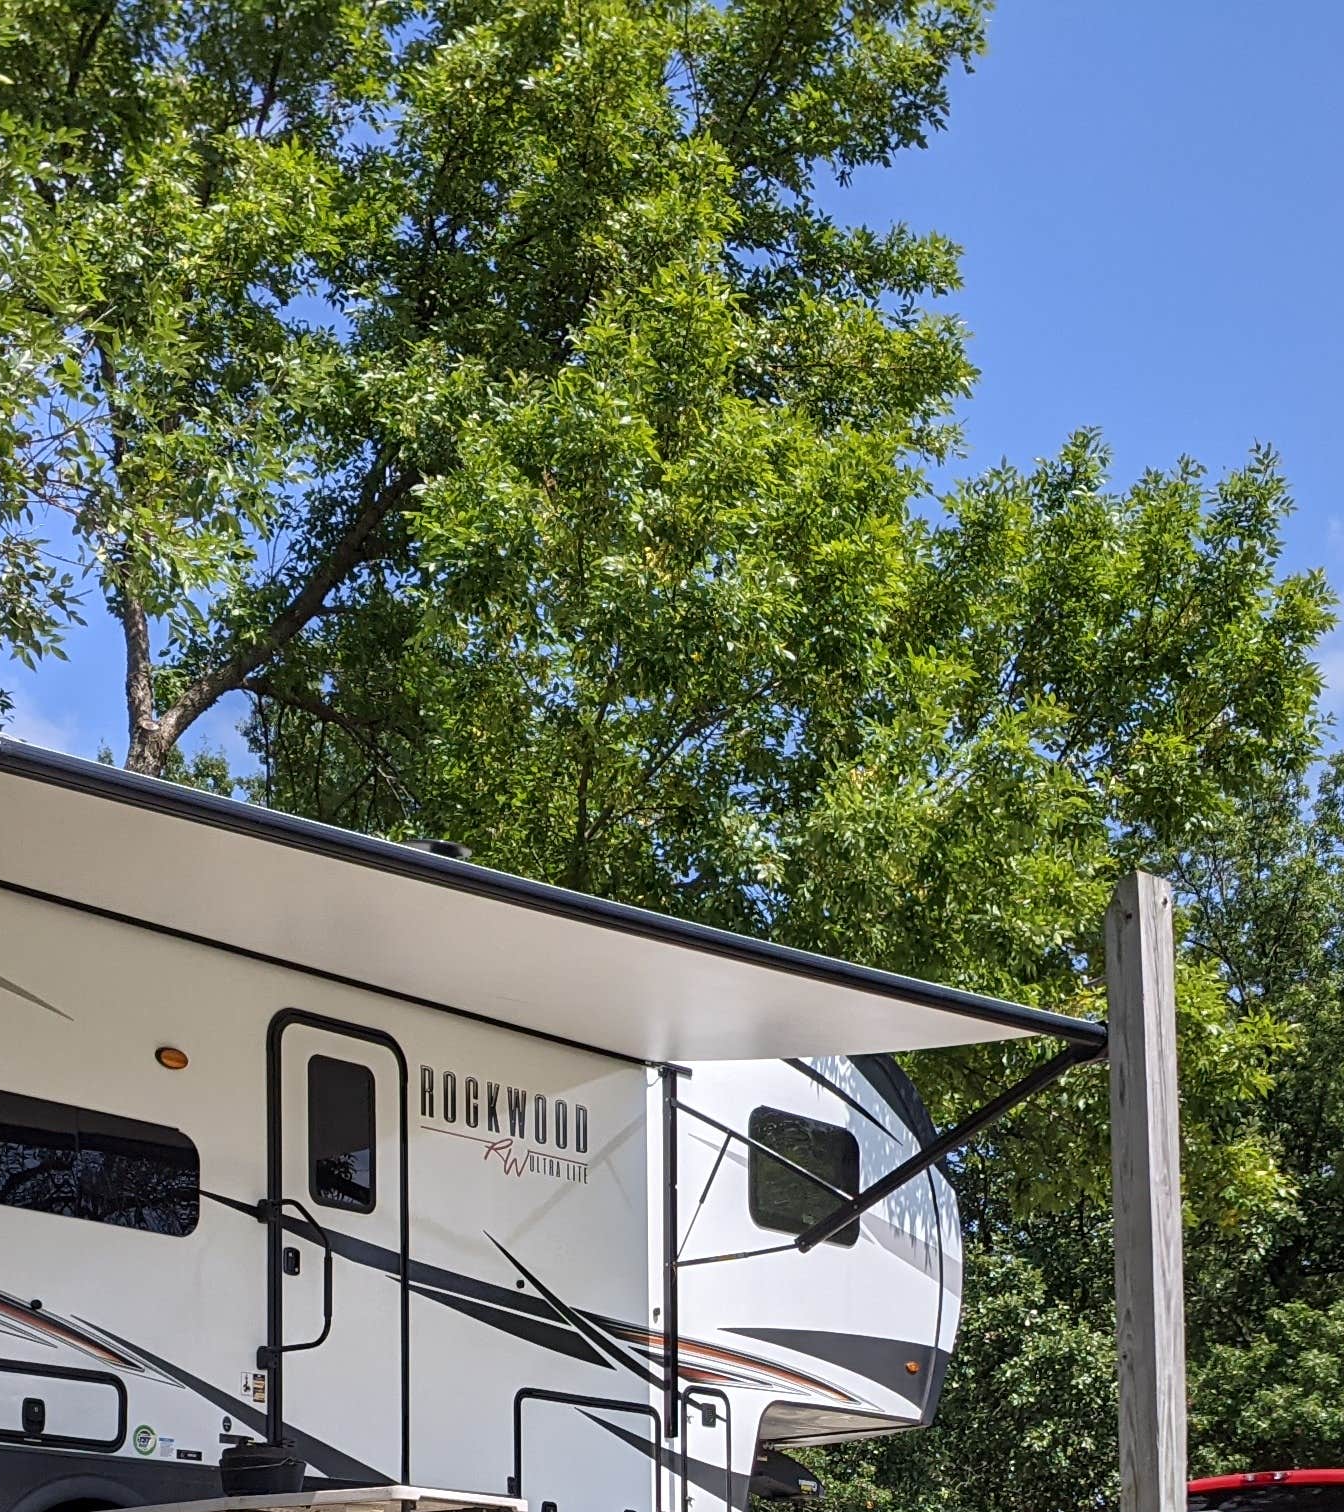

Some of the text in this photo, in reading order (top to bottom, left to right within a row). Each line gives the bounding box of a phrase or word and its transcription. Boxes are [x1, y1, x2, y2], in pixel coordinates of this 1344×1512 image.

[419, 1064, 588, 1154] ROCKWOOD
[483, 1138, 588, 1184] RW ULTRA LITE
